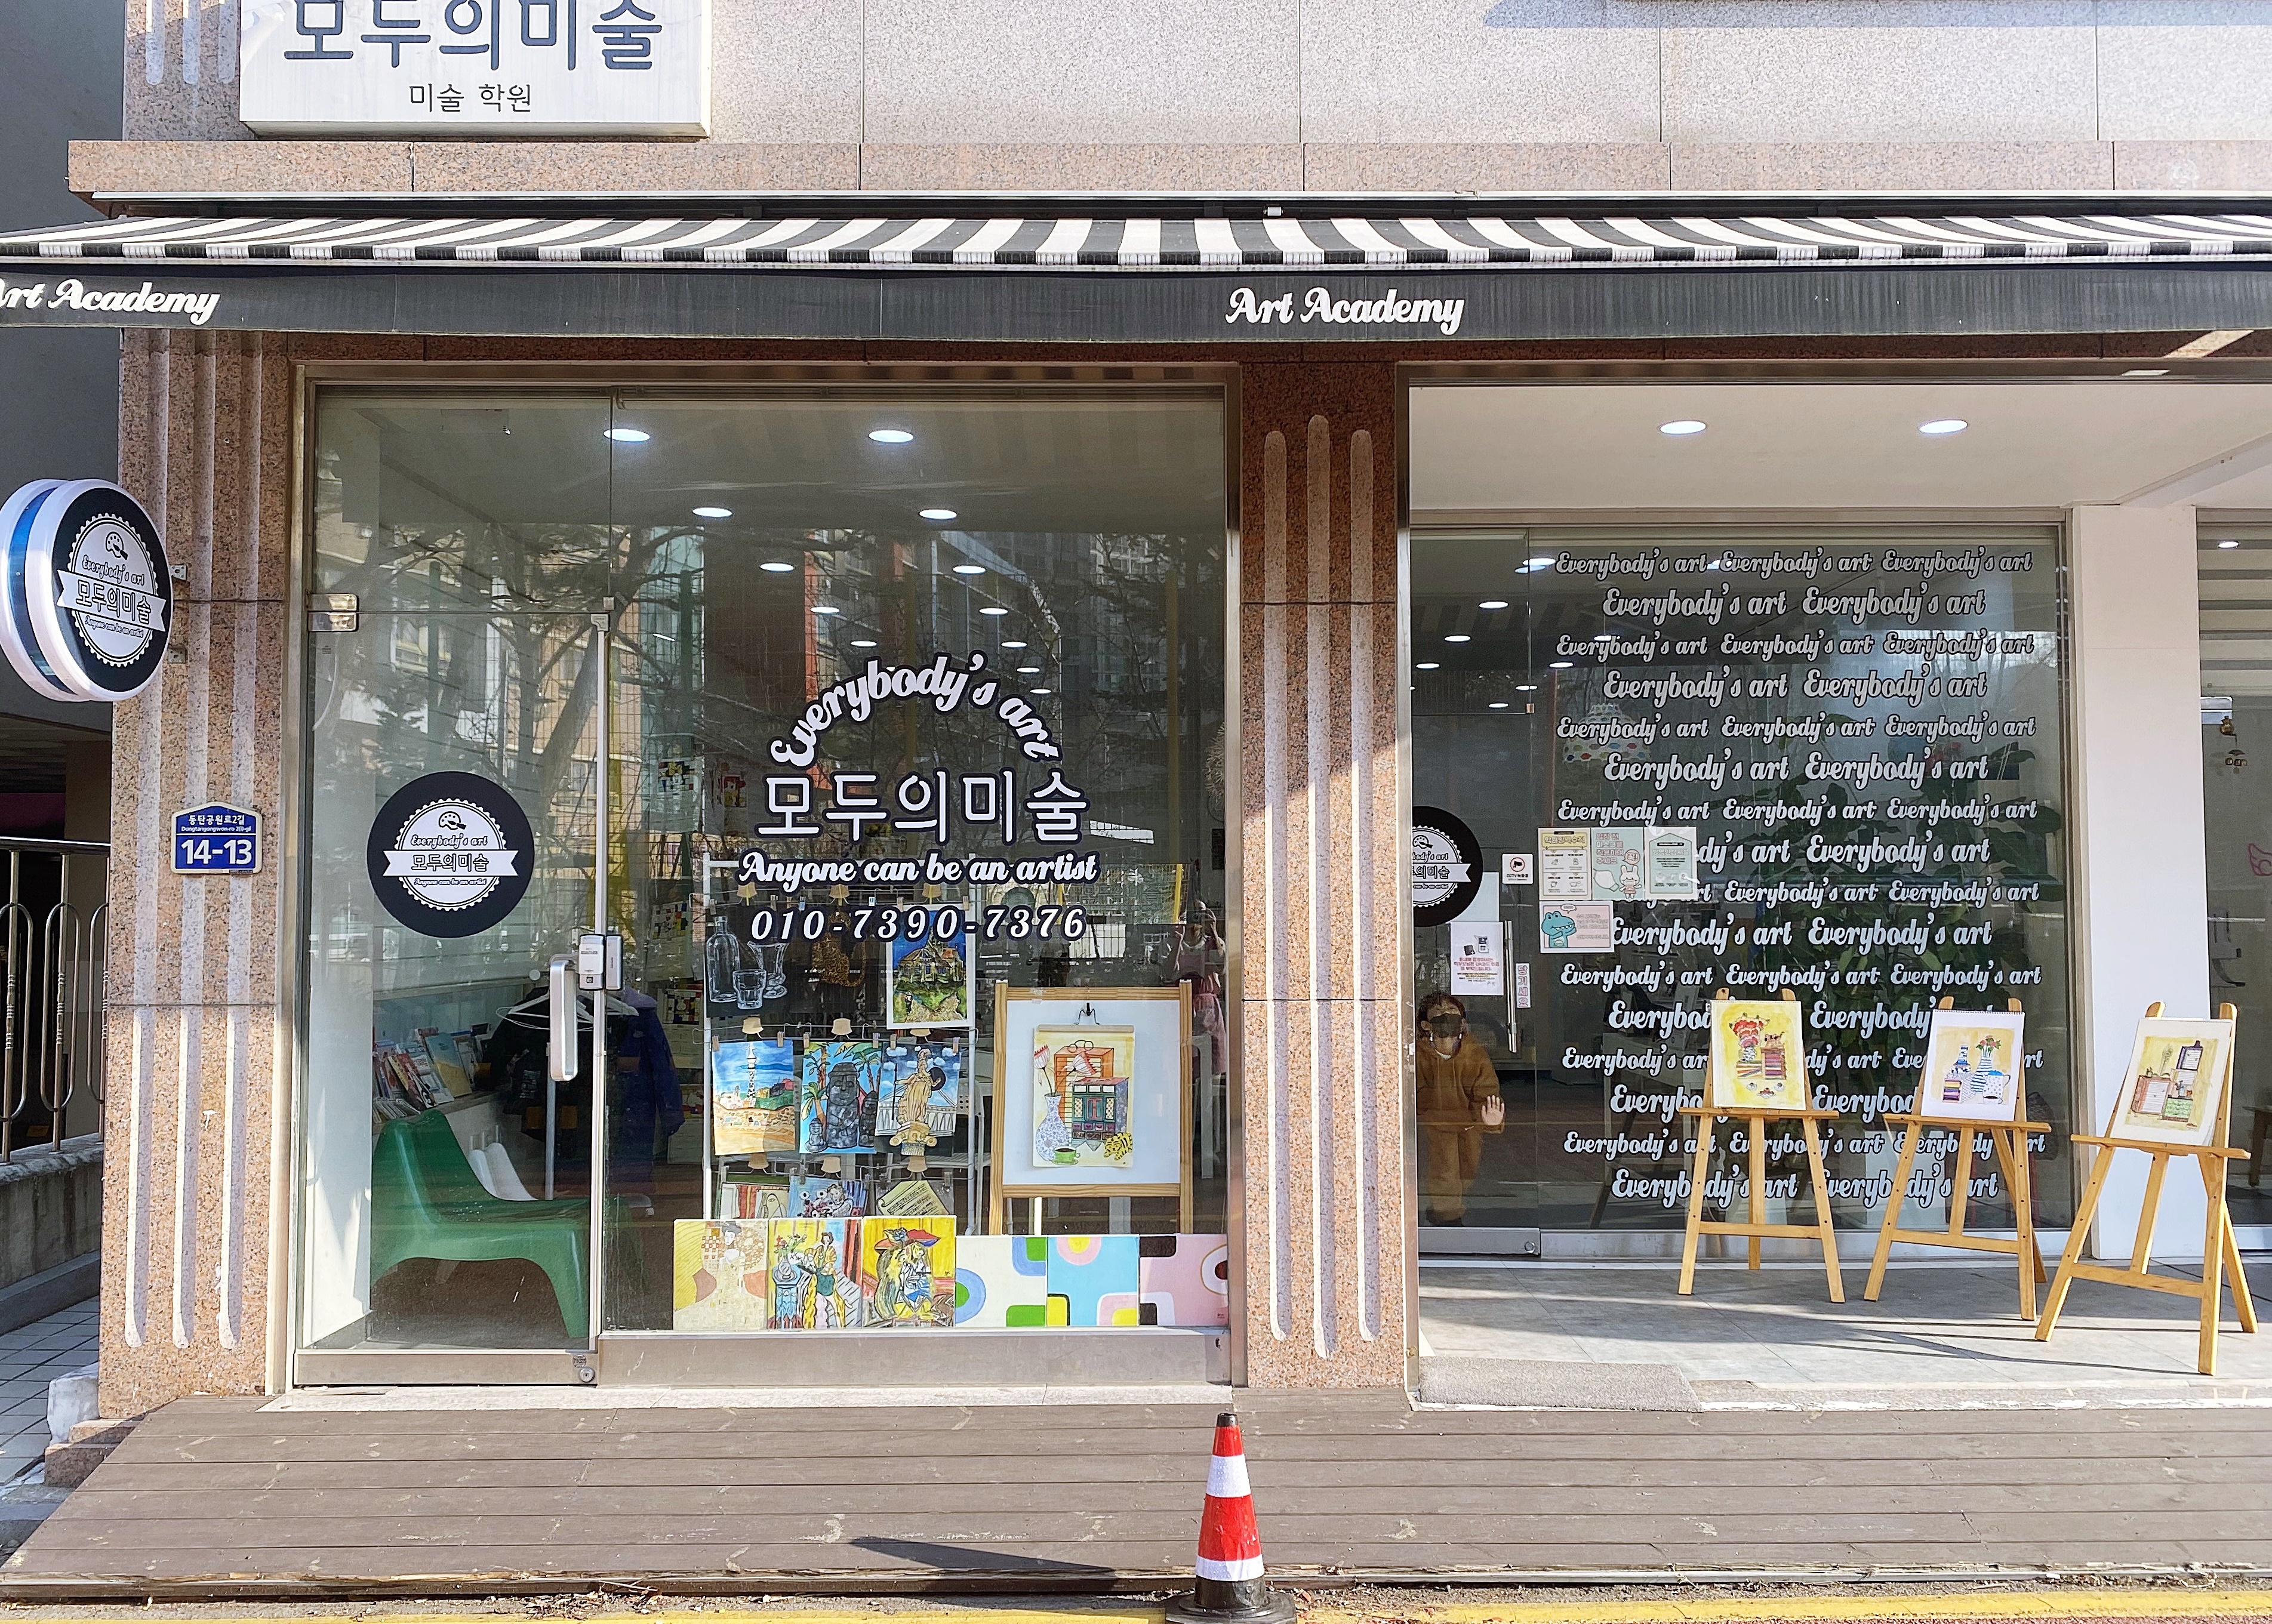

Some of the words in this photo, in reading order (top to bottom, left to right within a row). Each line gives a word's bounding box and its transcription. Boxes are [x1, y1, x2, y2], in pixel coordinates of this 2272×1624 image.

[283, 0, 664, 72] 모두의미술
[409, 82, 466, 114] 미술
[478, 82, 533, 113] 학원
[0, 278, 47, 309] rt
[47, 278, 221, 326] Academy
[1226, 286, 1294, 324] Art
[1300, 286, 1465, 335] Academy
[82, 554, 130, 584] Everybody's
[131, 574, 145, 586] art
[1556, 547, 1668, 580] Everybody's
[1674, 554, 1707, 572] art
[1720, 547, 1832, 579] Everybody's
[1838, 553, 1873, 571] art
[1882, 546, 1993, 578] Everybody's
[2000, 553, 2031, 570] art
[75, 580, 152, 624] 모두의미술
[1603, 583, 1740, 625] Everybody's
[1748, 589, 1787, 615] art
[1802, 582, 1938, 624] Everybody's
[1946, 588, 1985, 614] art
[1556, 630, 1669, 662] Everybody's
[1676, 637, 1708, 655] art
[1720, 629, 1833, 661] Everybody's
[1839, 636, 1874, 654] art
[1883, 628, 1996, 661] Everybody's
[2002, 635, 2034, 654] art
[1603, 665, 1741, 708] Everybody's
[1748, 672, 1788, 698] art
[1803, 664, 1940, 707] Everybody's
[1948, 671, 1986, 697] art
[770, 653, 998, 768] Everybody's
[999, 697, 1061, 762] art
[1557, 712, 1670, 745] Everybody's
[1676, 719, 1709, 737] art
[1722, 711, 1834, 744] Everybody's
[1841, 719, 1876, 736] art
[1885, 710, 1997, 743] Everybody's
[2003, 718, 2035, 735] art
[1604, 747, 1743, 791] Everybody's
[1750, 755, 1789, 781] art
[1805, 747, 1942, 790] Everybody's
[1950, 754, 1988, 779] art
[188, 815, 245, 825] 동탄공원로2길
[757, 771, 1088, 843] 모두의미술
[1557, 795, 1671, 828] Everybody's
[1677, 802, 1710, 819] art
[1723, 794, 1836, 827] Everybody's
[1842, 801, 1877, 819] art
[1887, 793, 1999, 826] Everybody's
[2005, 800, 2037, 818] art
[181, 839, 253, 865] 14-13
[411, 833, 469, 849] Everybody's
[470, 836, 488, 846] art
[1412, 850, 1435, 864] body's
[1436, 852, 1449, 861] art
[1751, 838, 1791, 863] art
[1806, 830, 1944, 873] Everybody's
[1951, 838, 1990, 863] art
[411, 853, 490, 873] 모두의미술
[738, 852, 857, 893] Anyone
[863, 858, 920, 882] can
[926, 853, 962, 882] be
[968, 858, 1009, 882] an
[1016, 853, 1098, 882] artist
[1412, 865, 1450, 880] 의미술
[414, 877, 438, 888] Anyone
[469, 877, 487, 886] artist
[1697, 883, 1711, 901] rt
[1724, 877, 1838, 910] Everybody's
[1844, 883, 1879, 901] art
[1888, 876, 2001, 908] Everybody's
[2008, 883, 2040, 901] art
[750, 908, 1087, 941] 010-7390-7376
[1753, 920, 1793, 945] art
[1808, 912, 1945, 956] Everybody's
[1953, 920, 1992, 945] art
[1517, 965, 1529, 1007] 당기세요
[1560, 960, 1674, 993] Everybody's
[1680, 967, 1713, 985] art
[1726, 960, 1840, 993] Everybody's
[1846, 967, 1880, 985] art
[1890, 959, 2003, 992] Everybody's
[2009, 966, 2042, 984] art
[1810, 996, 1937, 1040] Everybody'
[1562, 1044, 1676, 1077] Everybody's
[1682, 1055, 1707, 1069] ar
[1848, 1050, 1883, 1068] art
[2024, 1050, 2043, 1068] rt
[1563, 1128, 1678, 1161] Everybody's
[1683, 1135, 1717, 1154] at
[1849, 1134, 1885, 1153] art
[1612, 1164, 1750, 1208] Everybdy's
